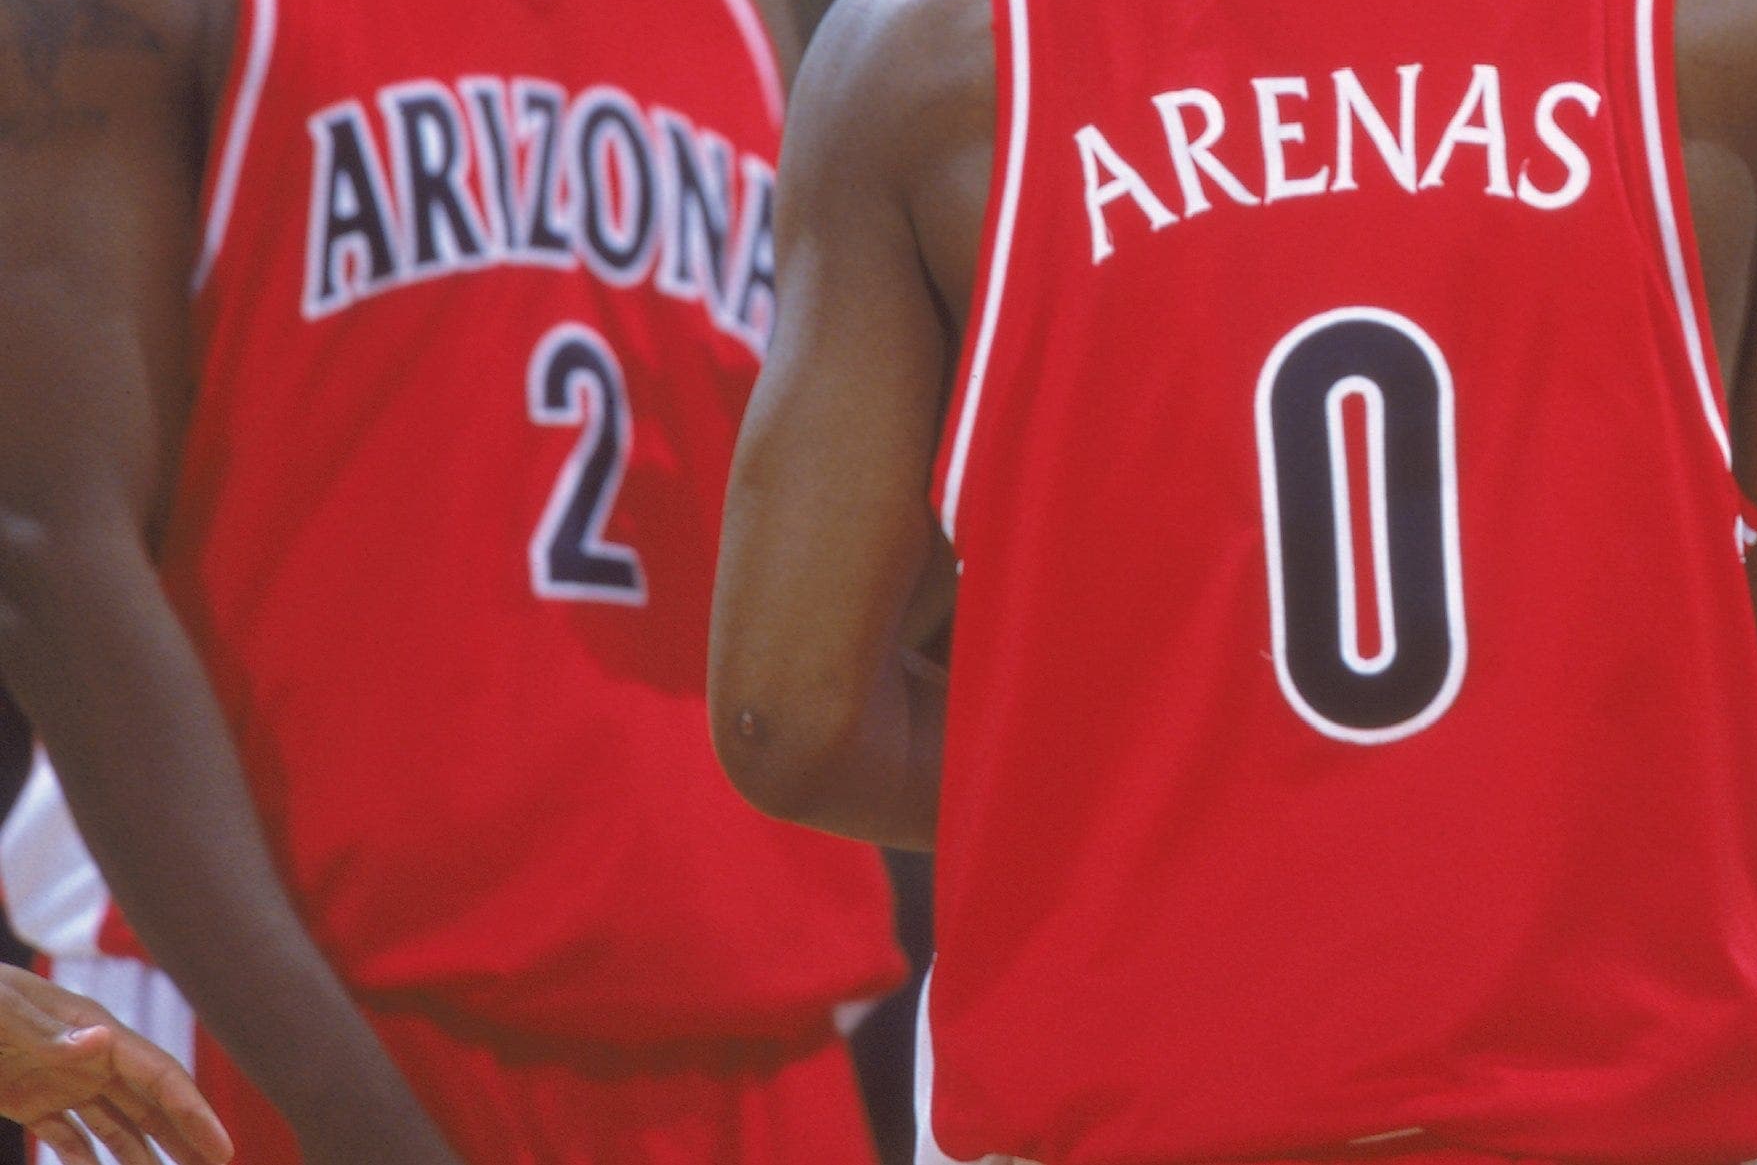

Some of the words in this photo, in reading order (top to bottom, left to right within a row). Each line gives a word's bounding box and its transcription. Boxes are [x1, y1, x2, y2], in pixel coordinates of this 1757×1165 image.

[302, 76, 777, 359] ARIZONA
[1073, 63, 1601, 265] ARENAS
[528, 321, 648, 606] 2
[1254, 306, 1467, 745] 0
